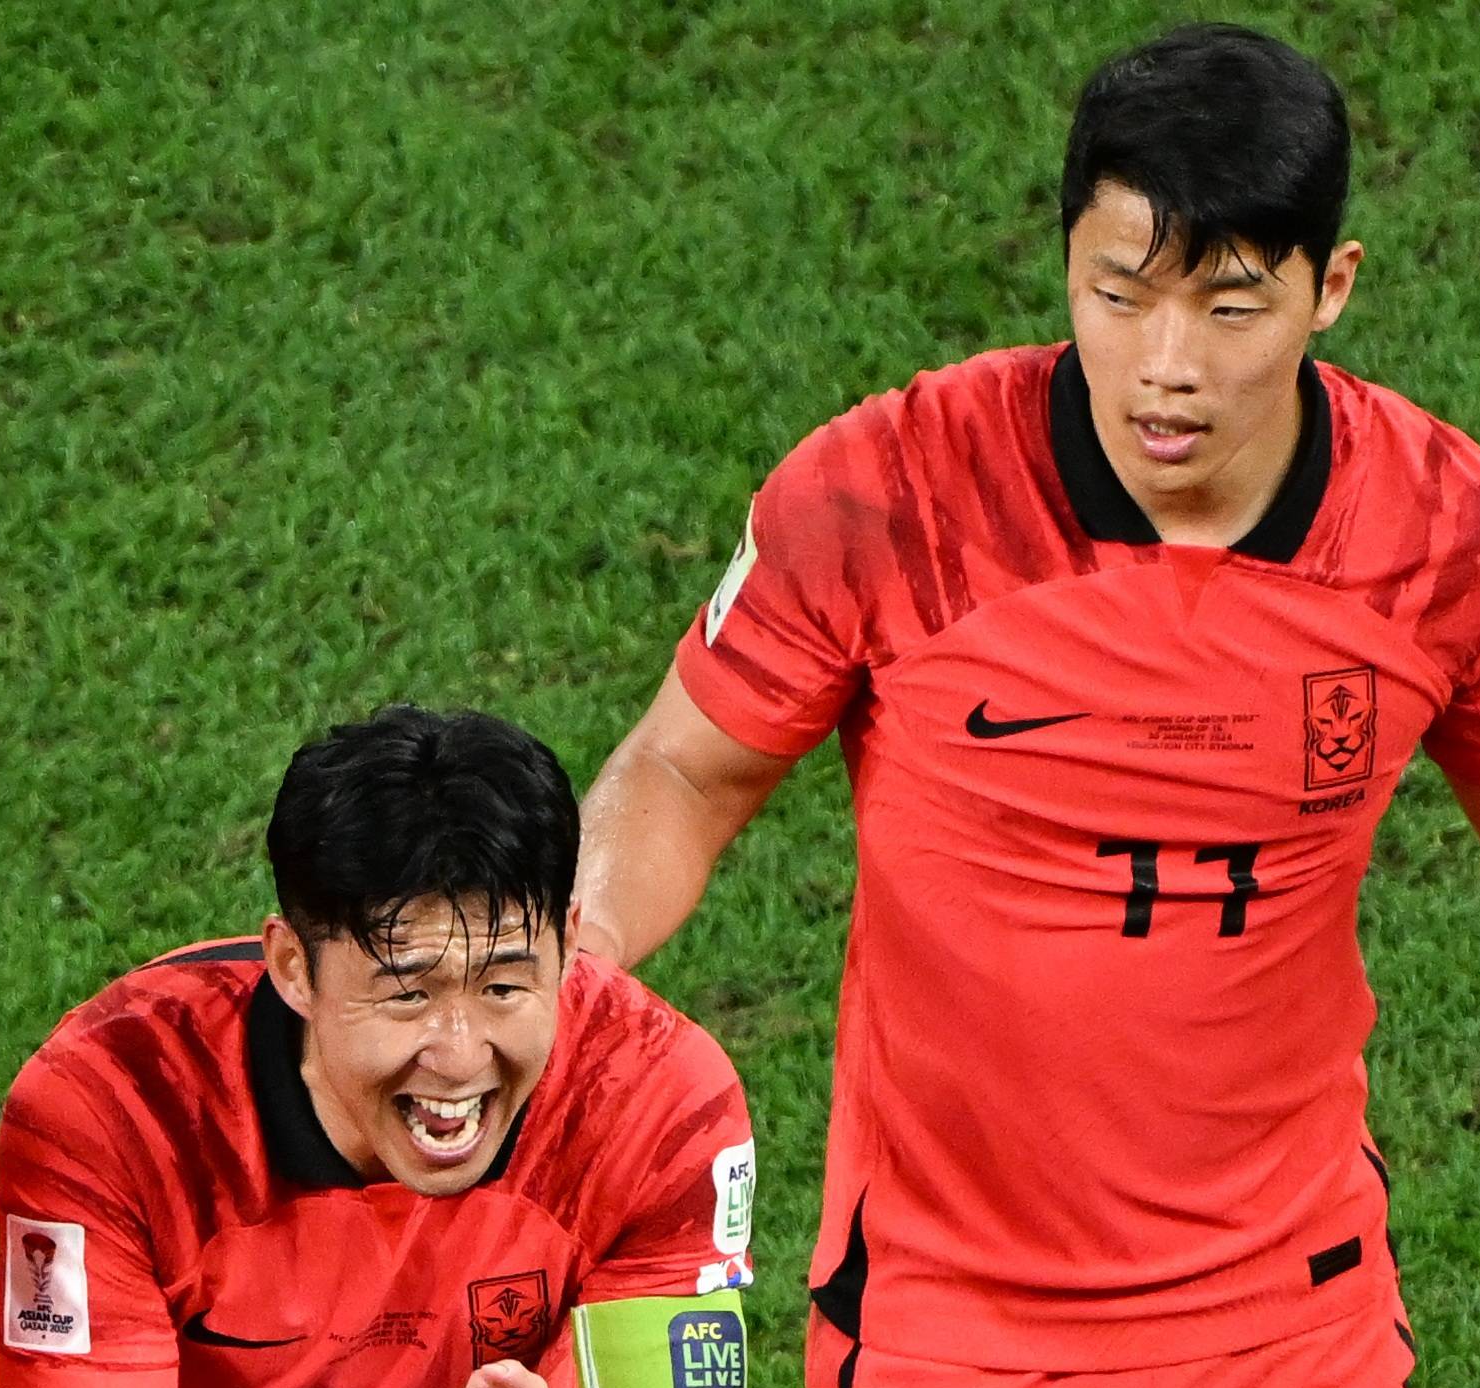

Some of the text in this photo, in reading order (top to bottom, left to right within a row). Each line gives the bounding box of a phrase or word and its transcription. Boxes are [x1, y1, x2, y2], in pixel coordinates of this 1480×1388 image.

[1298, 787, 1366, 816] KOREA
[1096, 839, 1262, 938] 11
[728, 1160, 749, 1182] AFC
[18, 1309, 74, 1325] ASIAN CUP
[20, 1320, 48, 1331] QATAR
[682, 1321, 723, 1340] AFC
[682, 1341, 741, 1370] LIVE
